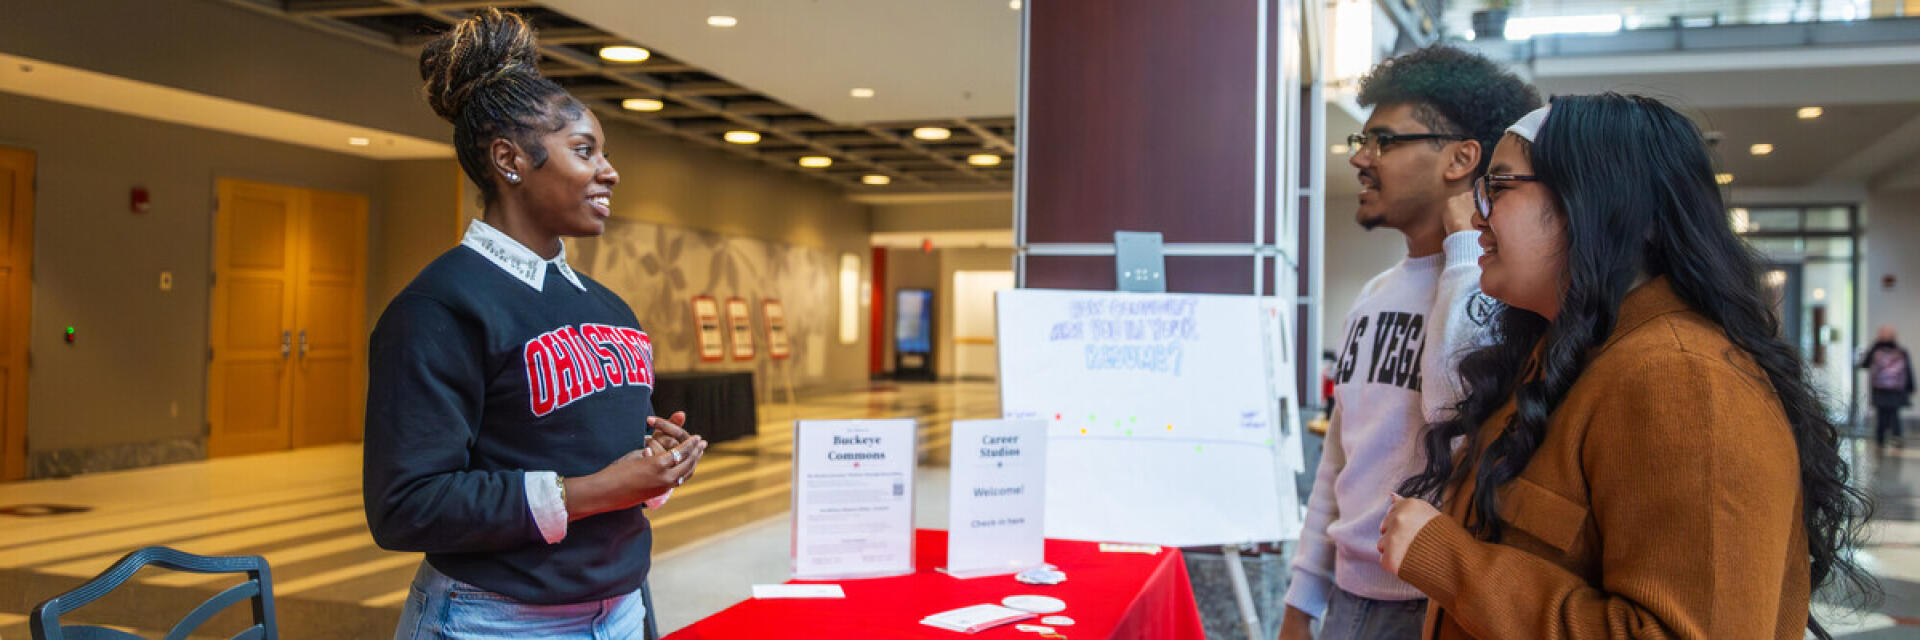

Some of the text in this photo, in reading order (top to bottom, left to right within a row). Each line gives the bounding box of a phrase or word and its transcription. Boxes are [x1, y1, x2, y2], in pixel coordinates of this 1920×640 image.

[832, 434, 882, 448] Buckeye
[982, 434, 1019, 445] Career
[827, 450, 886, 461] Commons
[980, 447, 1021, 457] Studios
